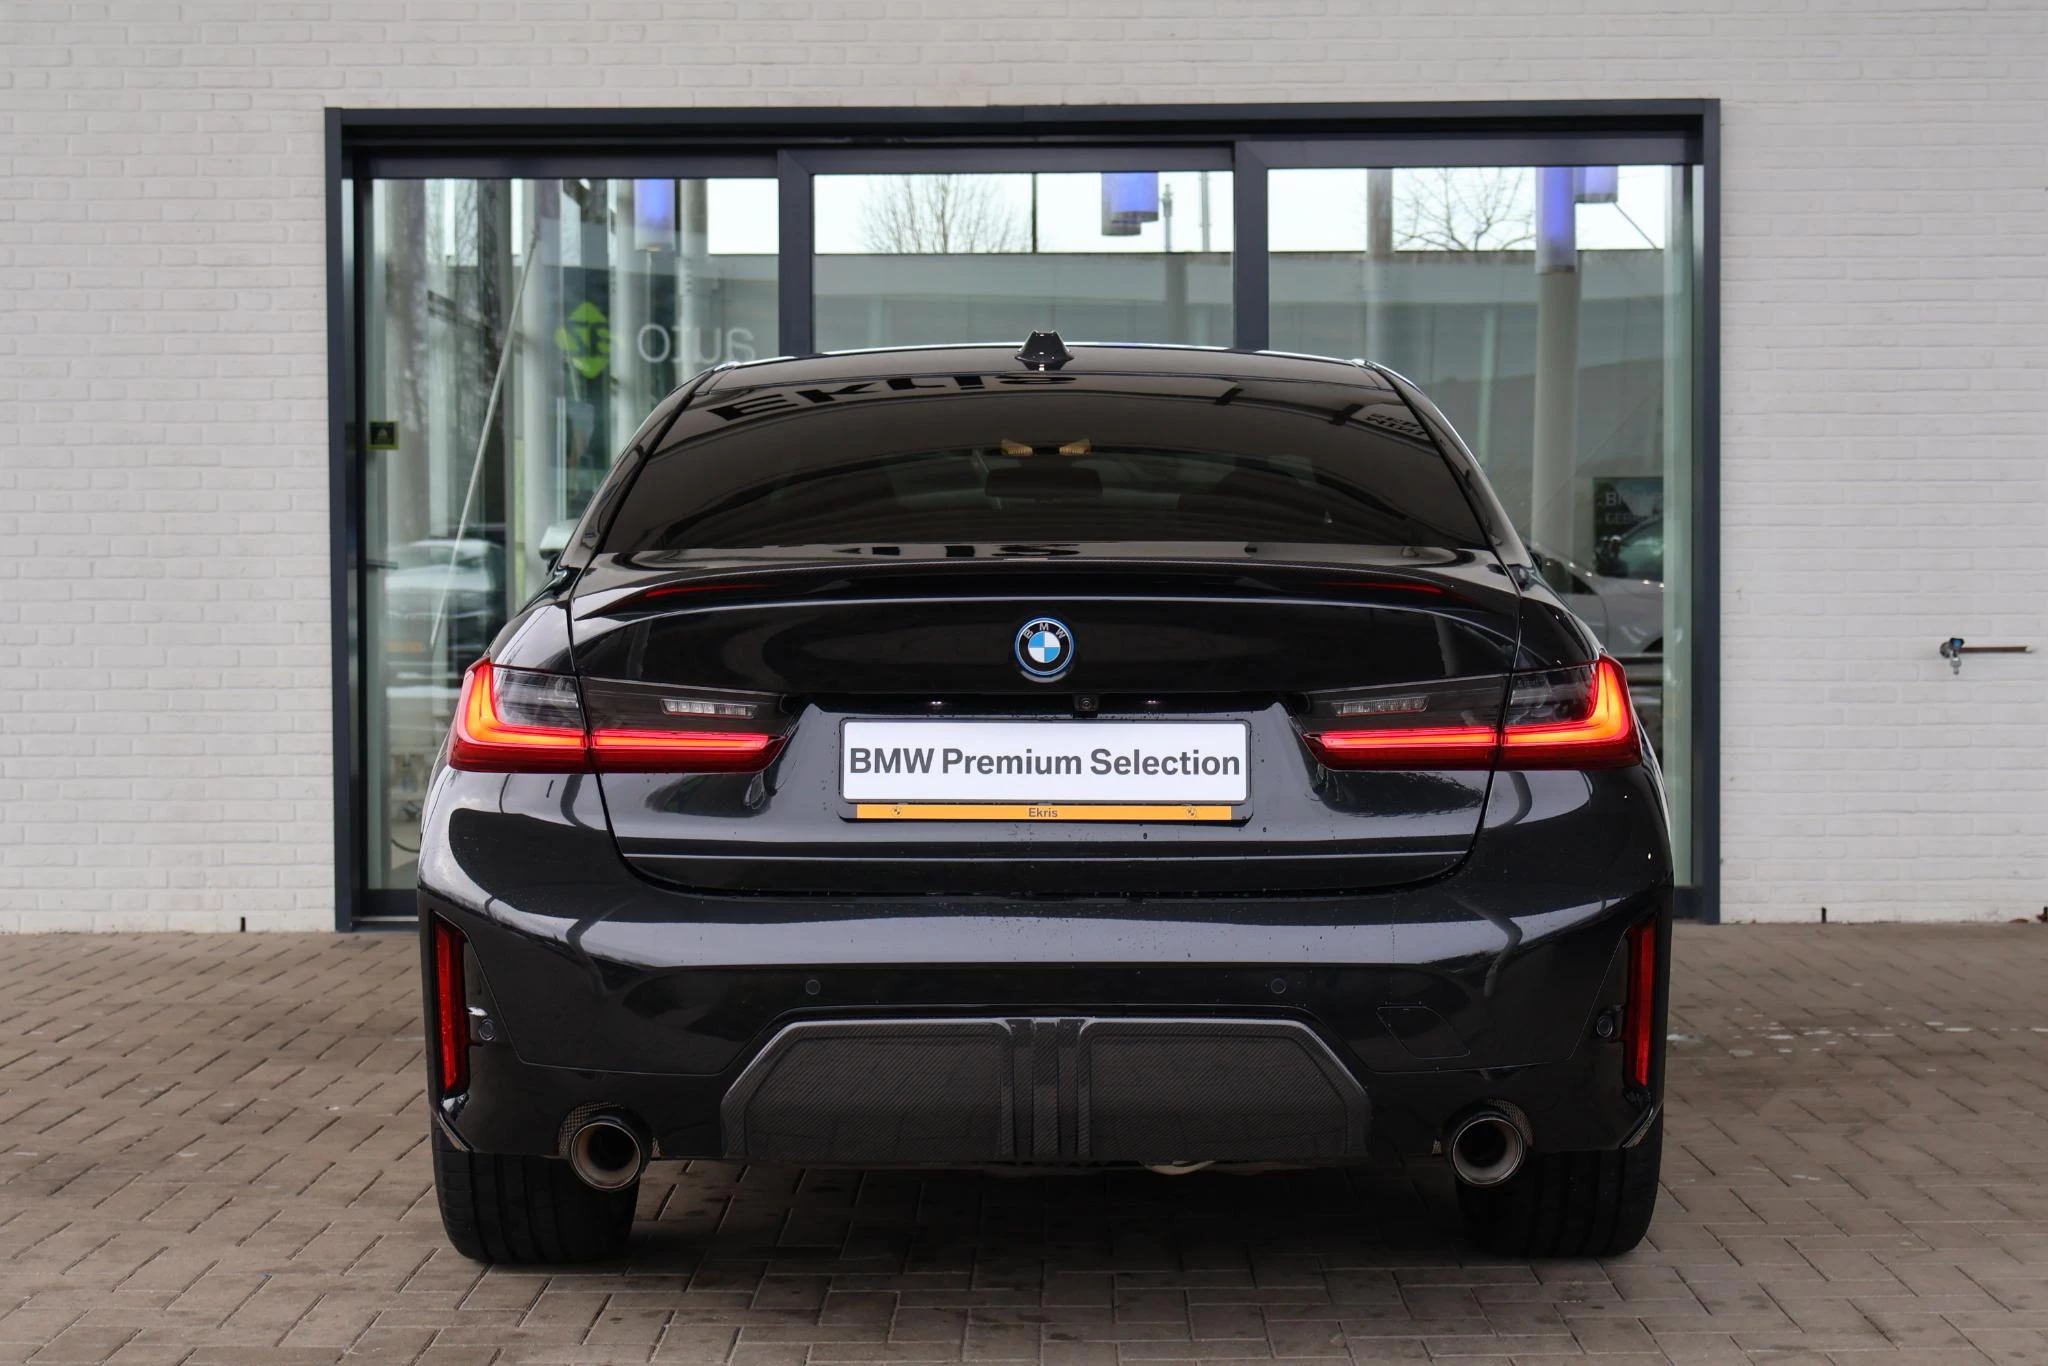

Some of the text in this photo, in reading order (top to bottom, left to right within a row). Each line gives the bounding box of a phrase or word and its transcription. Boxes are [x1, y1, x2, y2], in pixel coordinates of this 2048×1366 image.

[1023, 622, 1067, 640] BMW
[850, 747, 1241, 776] BMW Premium Selection
[1028, 807, 1058, 818] Ekris
